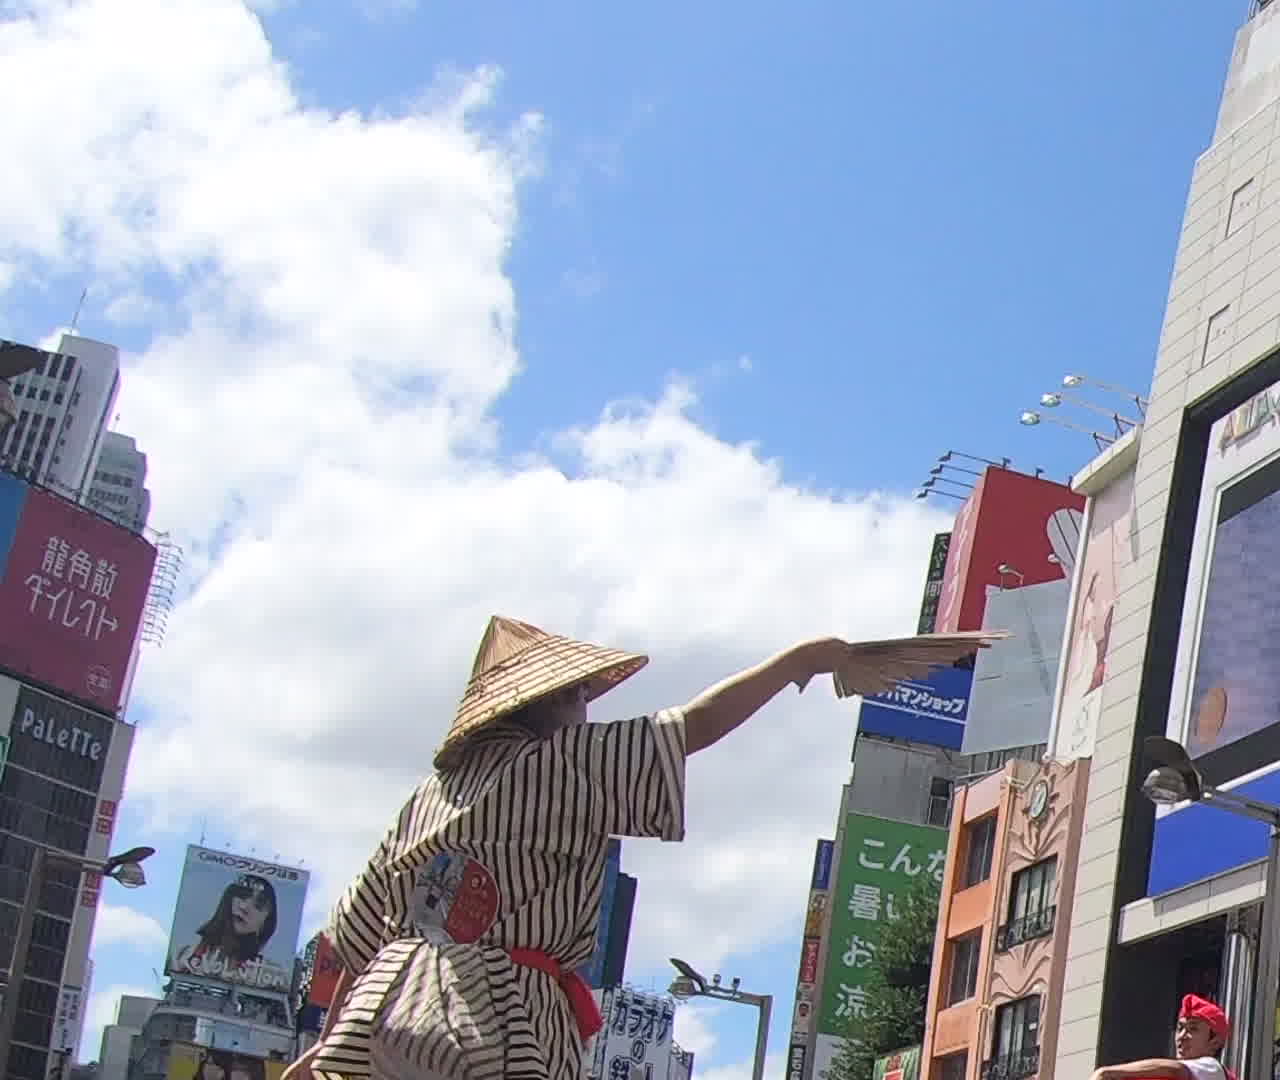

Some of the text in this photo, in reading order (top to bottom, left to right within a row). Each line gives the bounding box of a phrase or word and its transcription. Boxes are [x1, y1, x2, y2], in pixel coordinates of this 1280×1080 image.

[42, 535, 119, 600] 龍角散
[878, 685, 966, 714] パマンショップ
